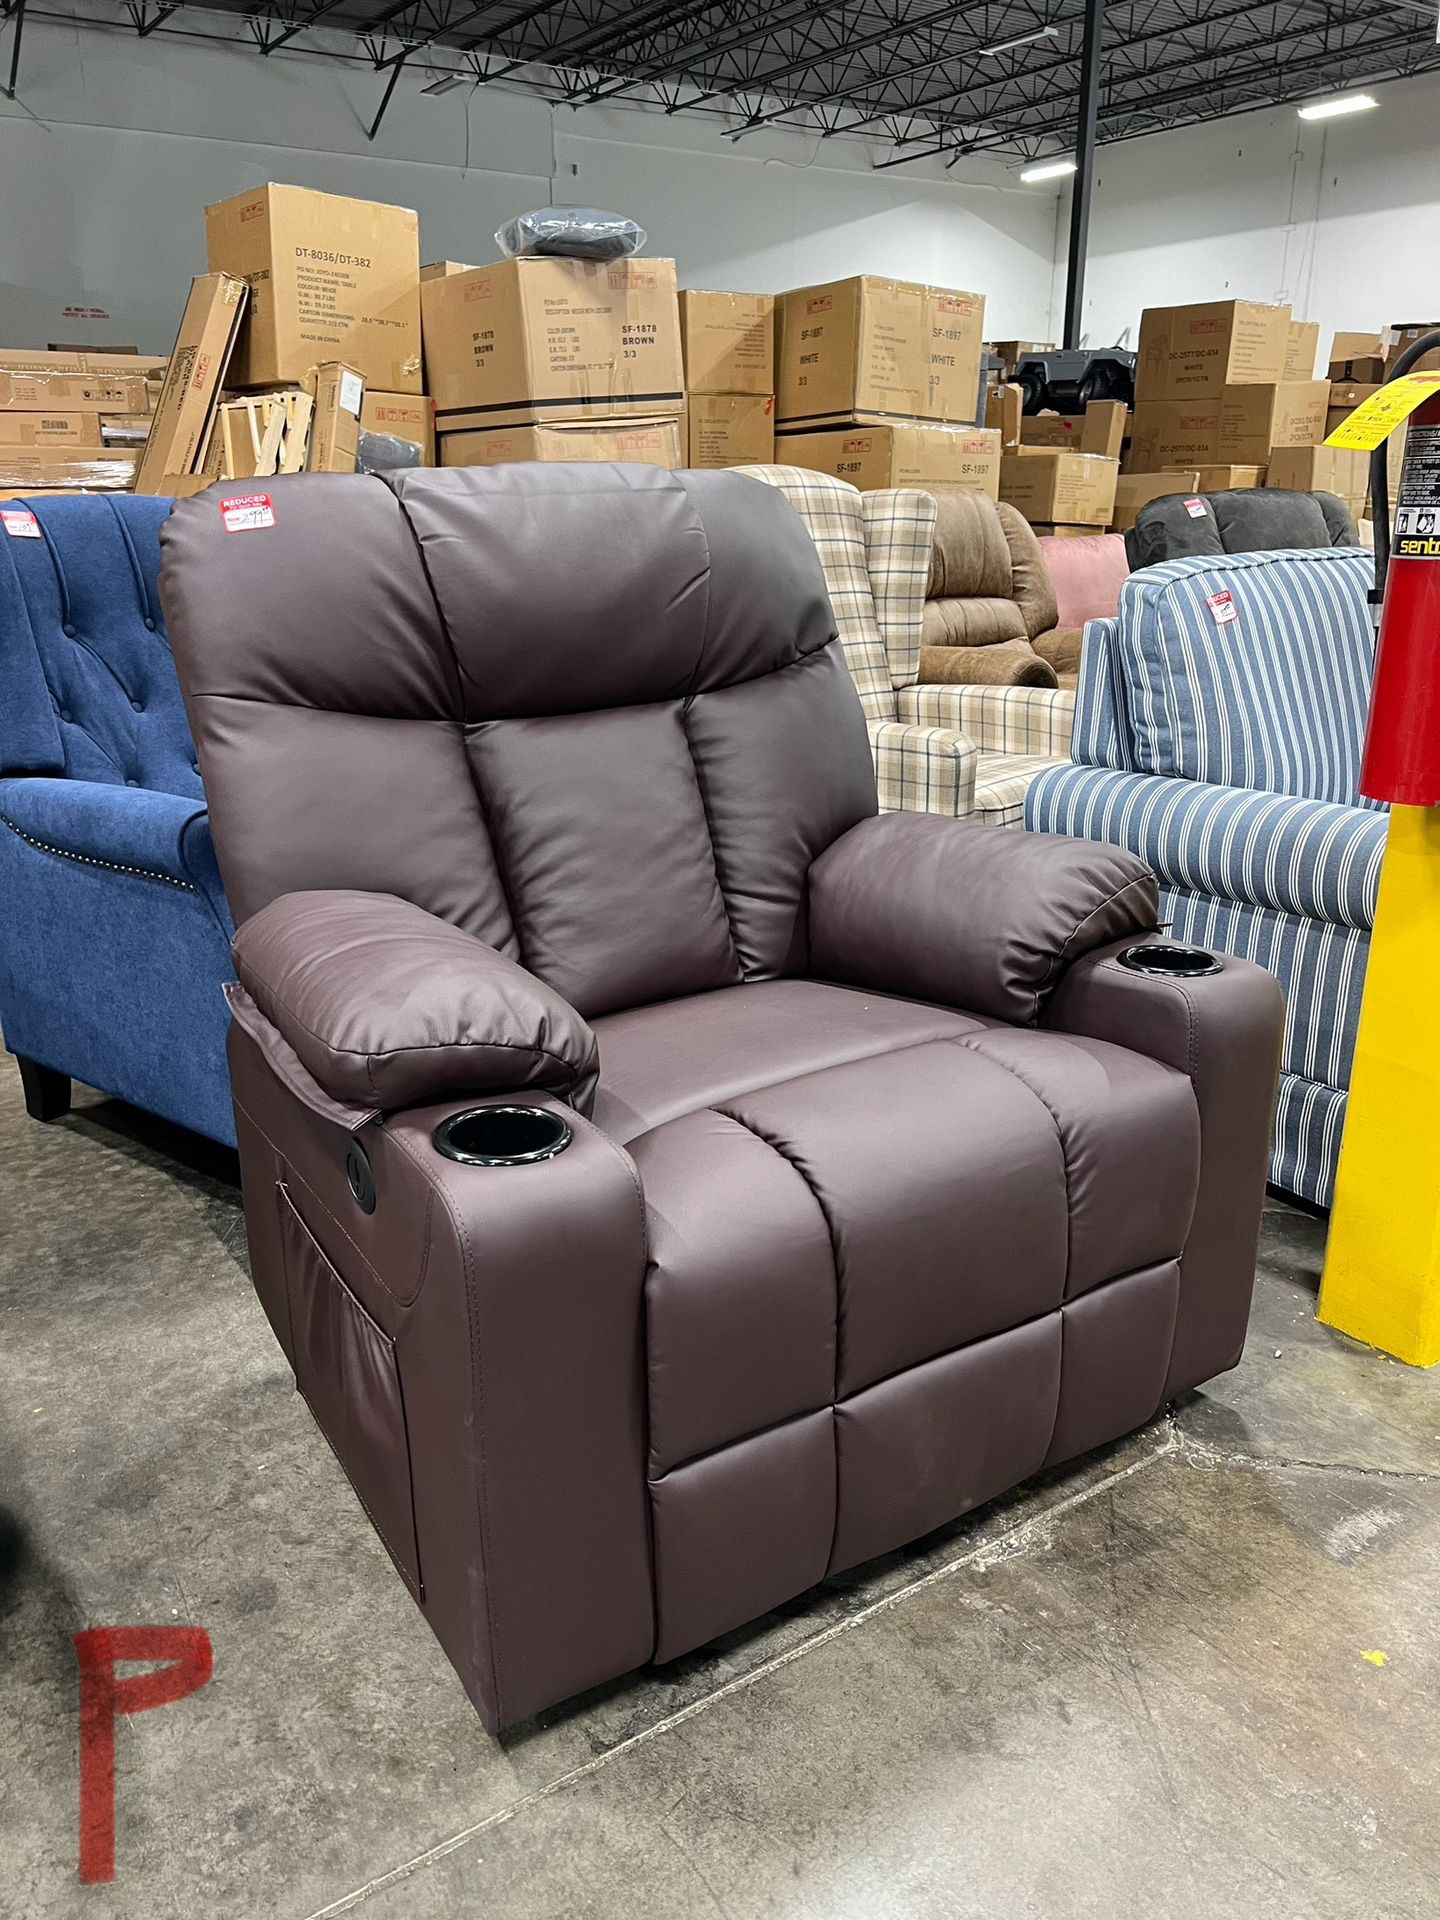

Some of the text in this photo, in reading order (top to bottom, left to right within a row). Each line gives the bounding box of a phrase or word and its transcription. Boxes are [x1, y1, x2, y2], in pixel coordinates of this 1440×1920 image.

[295, 246, 372, 268] DT-8036/DT-382
[622, 325, 657, 333] SF-1878
[932, 328, 961, 340] SF-1897
[622, 337, 655, 345] BROWN
[623, 350, 637, 358] 3/3
[800, 353, 819, 365] WHITE
[931, 354, 956, 366] WHITE
[961, 464, 989, 474] SF-1897
[223, 495, 267, 508] REDUCED
